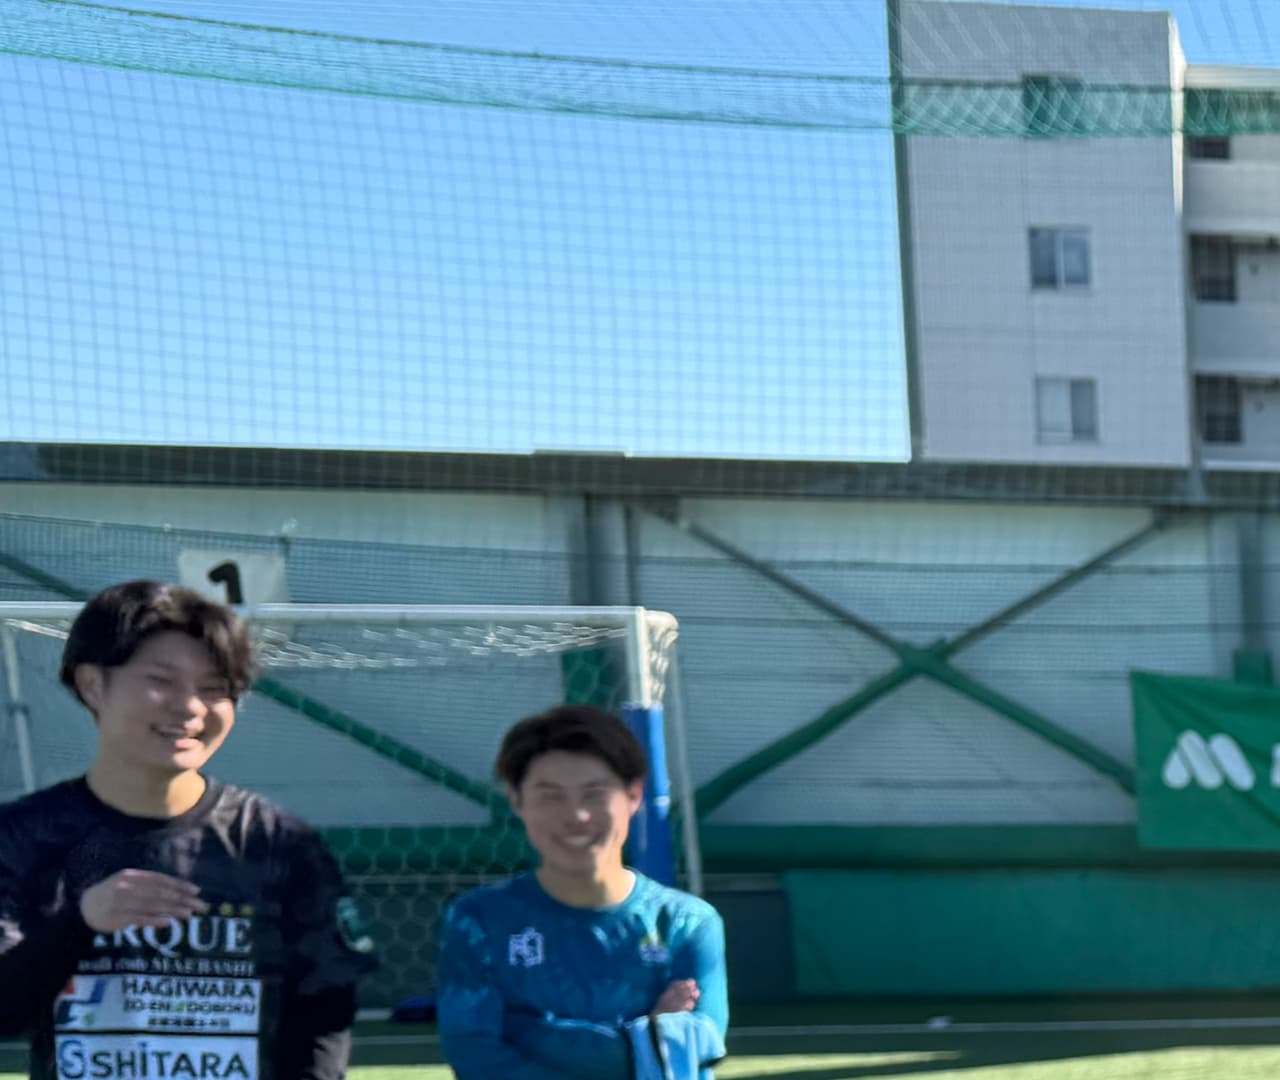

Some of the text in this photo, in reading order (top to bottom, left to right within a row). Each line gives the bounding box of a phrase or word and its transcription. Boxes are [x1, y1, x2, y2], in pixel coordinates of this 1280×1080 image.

[208, 559, 244, 604] 1
[93, 916, 252, 957] RQUE
[122, 976, 255, 998] HAGIWARA
